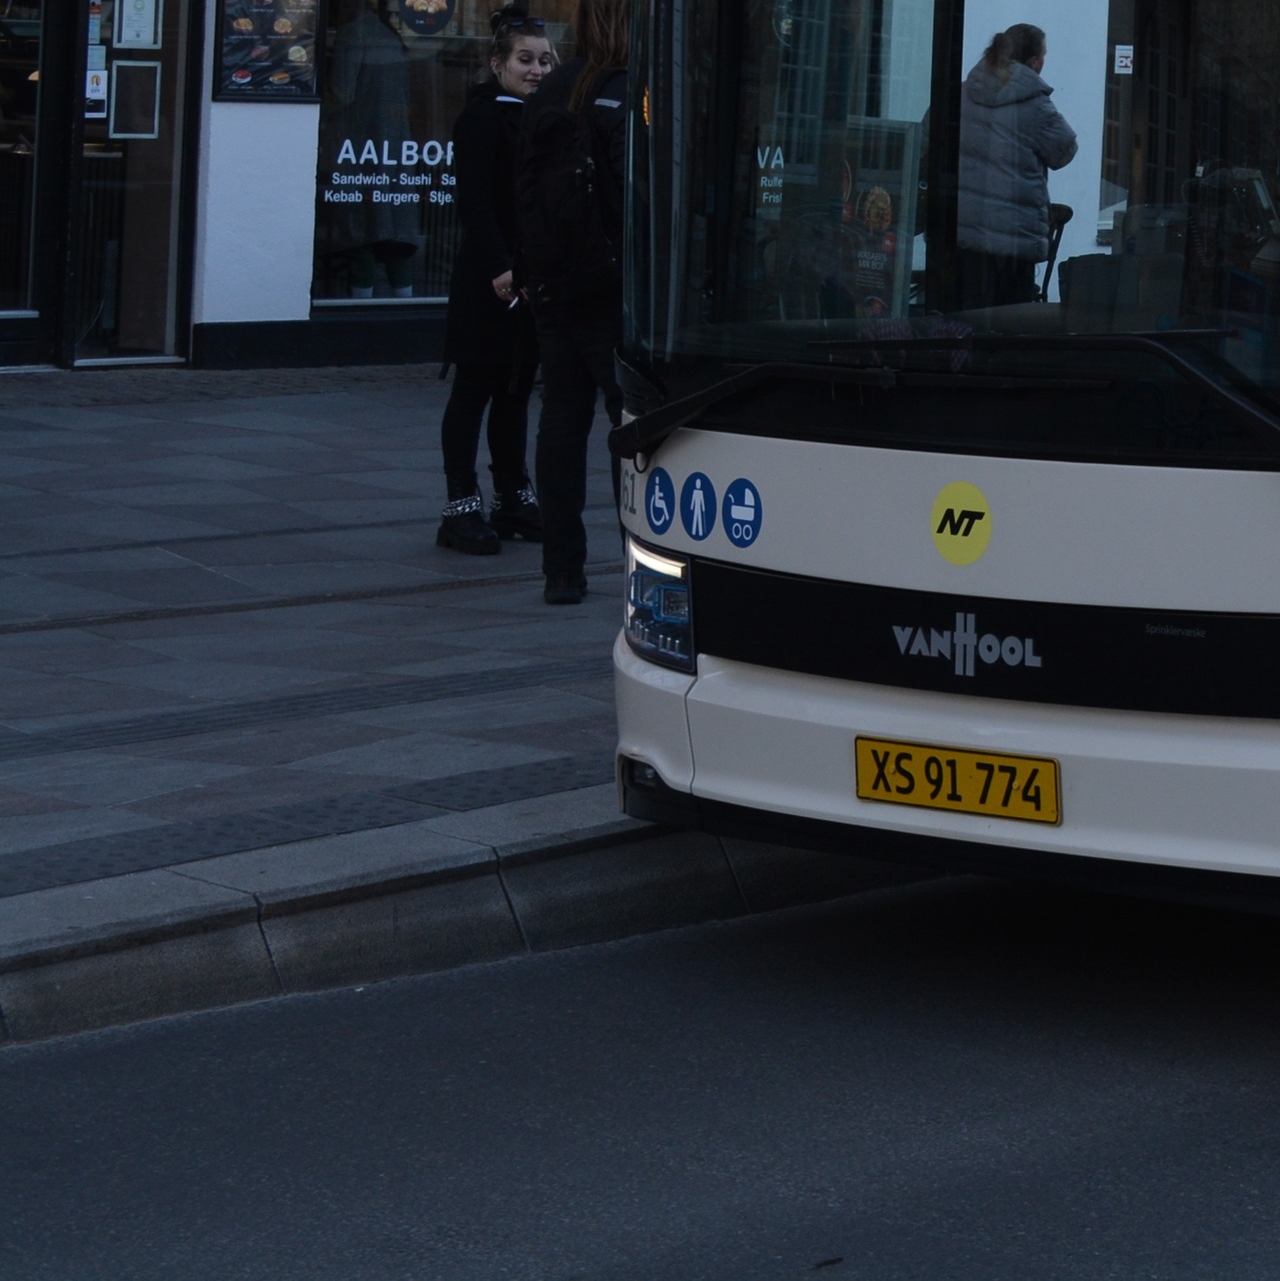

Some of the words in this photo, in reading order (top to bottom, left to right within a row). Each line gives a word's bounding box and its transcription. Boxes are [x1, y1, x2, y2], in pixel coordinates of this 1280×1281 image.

[332, 172, 390, 185] Sandwich
[400, 173, 432, 186] Sushi
[325, 190, 363, 203] Kebab
[372, 190, 420, 206] Burgere
[936, 507, 986, 537] NT
[870, 748, 916, 797] XS
[923, 755, 963, 803] 91
[974, 762, 1042, 812] 774
